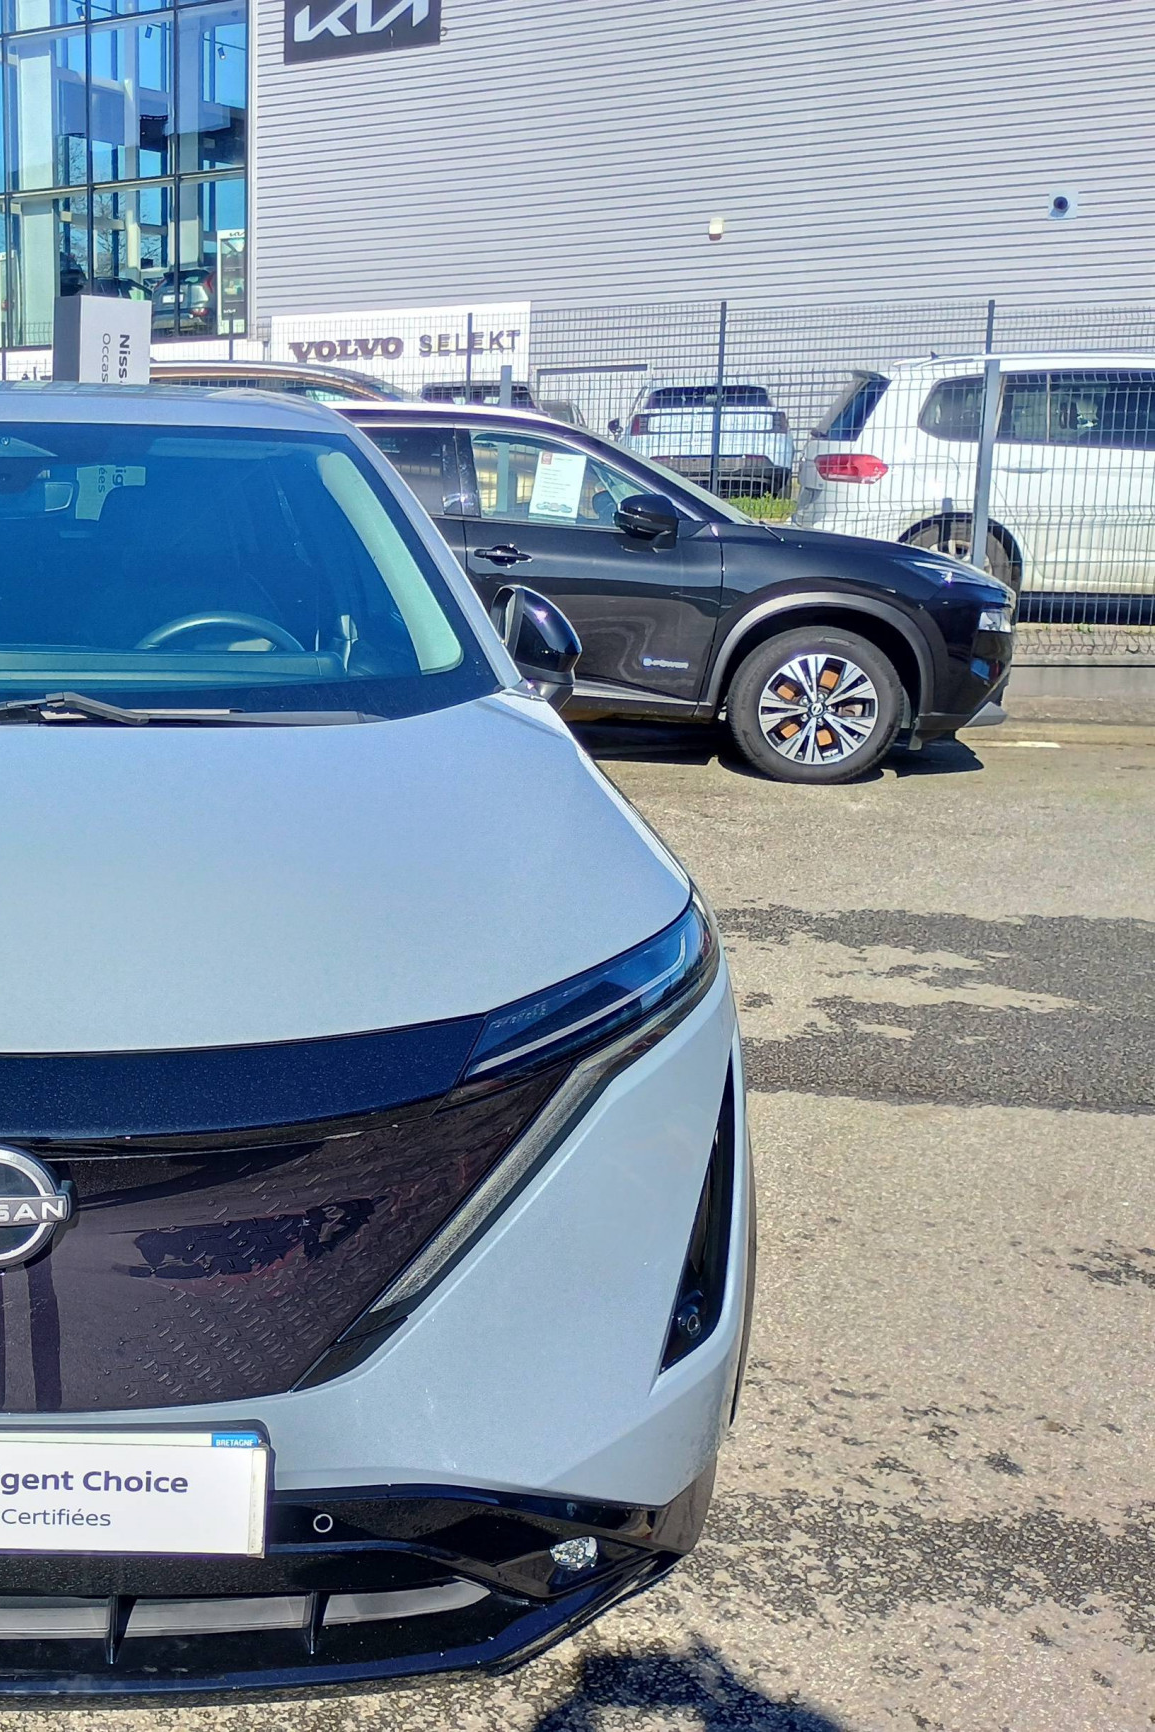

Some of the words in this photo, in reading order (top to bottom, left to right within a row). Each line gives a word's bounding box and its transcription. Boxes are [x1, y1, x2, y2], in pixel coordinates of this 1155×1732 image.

[101, 333, 111, 382] Occas
[119, 334, 130, 383] Niss
[288, 337, 404, 361] VOLVO
[419, 330, 521, 354] SELEKT
[215, 1438, 255, 1447] BRETAGNE
[82, 1470, 189, 1493] Choice
[1, 1508, 111, 1527] Certifiées
